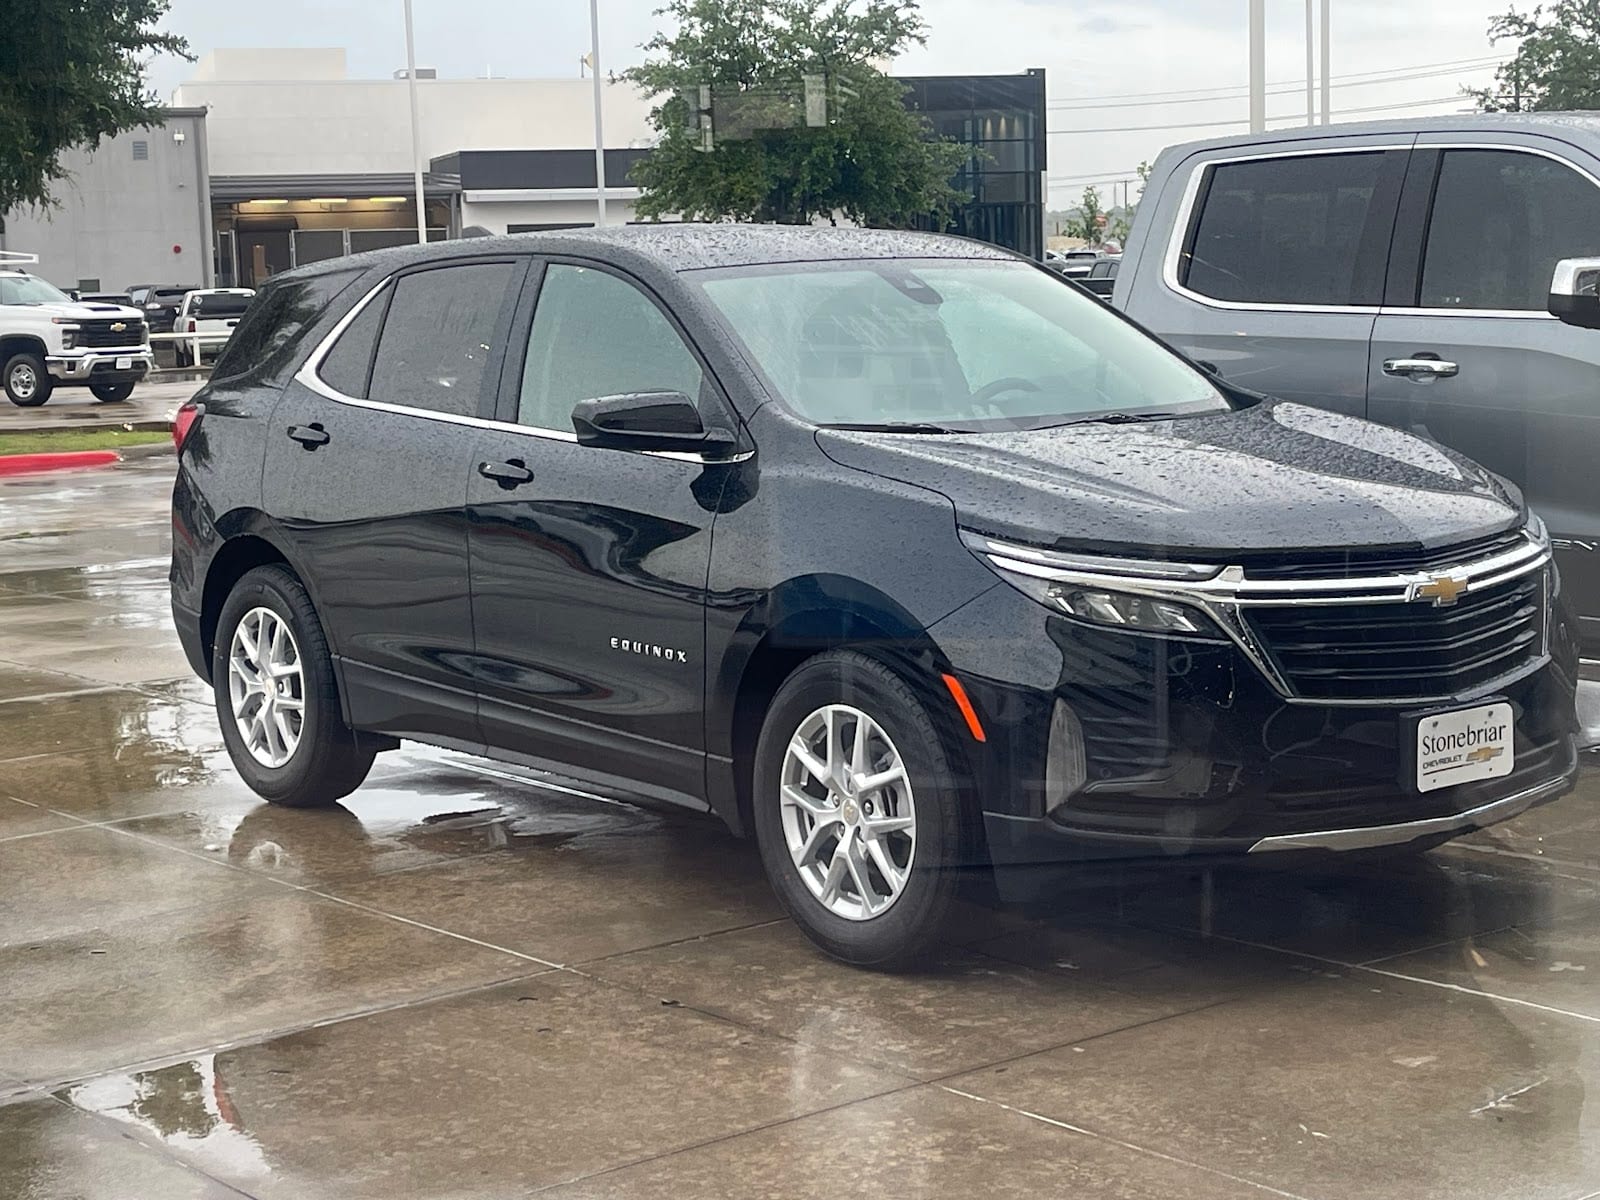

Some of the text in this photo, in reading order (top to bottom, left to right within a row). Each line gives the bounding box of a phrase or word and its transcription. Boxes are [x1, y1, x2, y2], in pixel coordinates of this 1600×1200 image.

[610, 637, 687, 663] EQUINOX
[1422, 720, 1507, 756] Stonebriar
[1422, 754, 1463, 769] CHEVROLET
